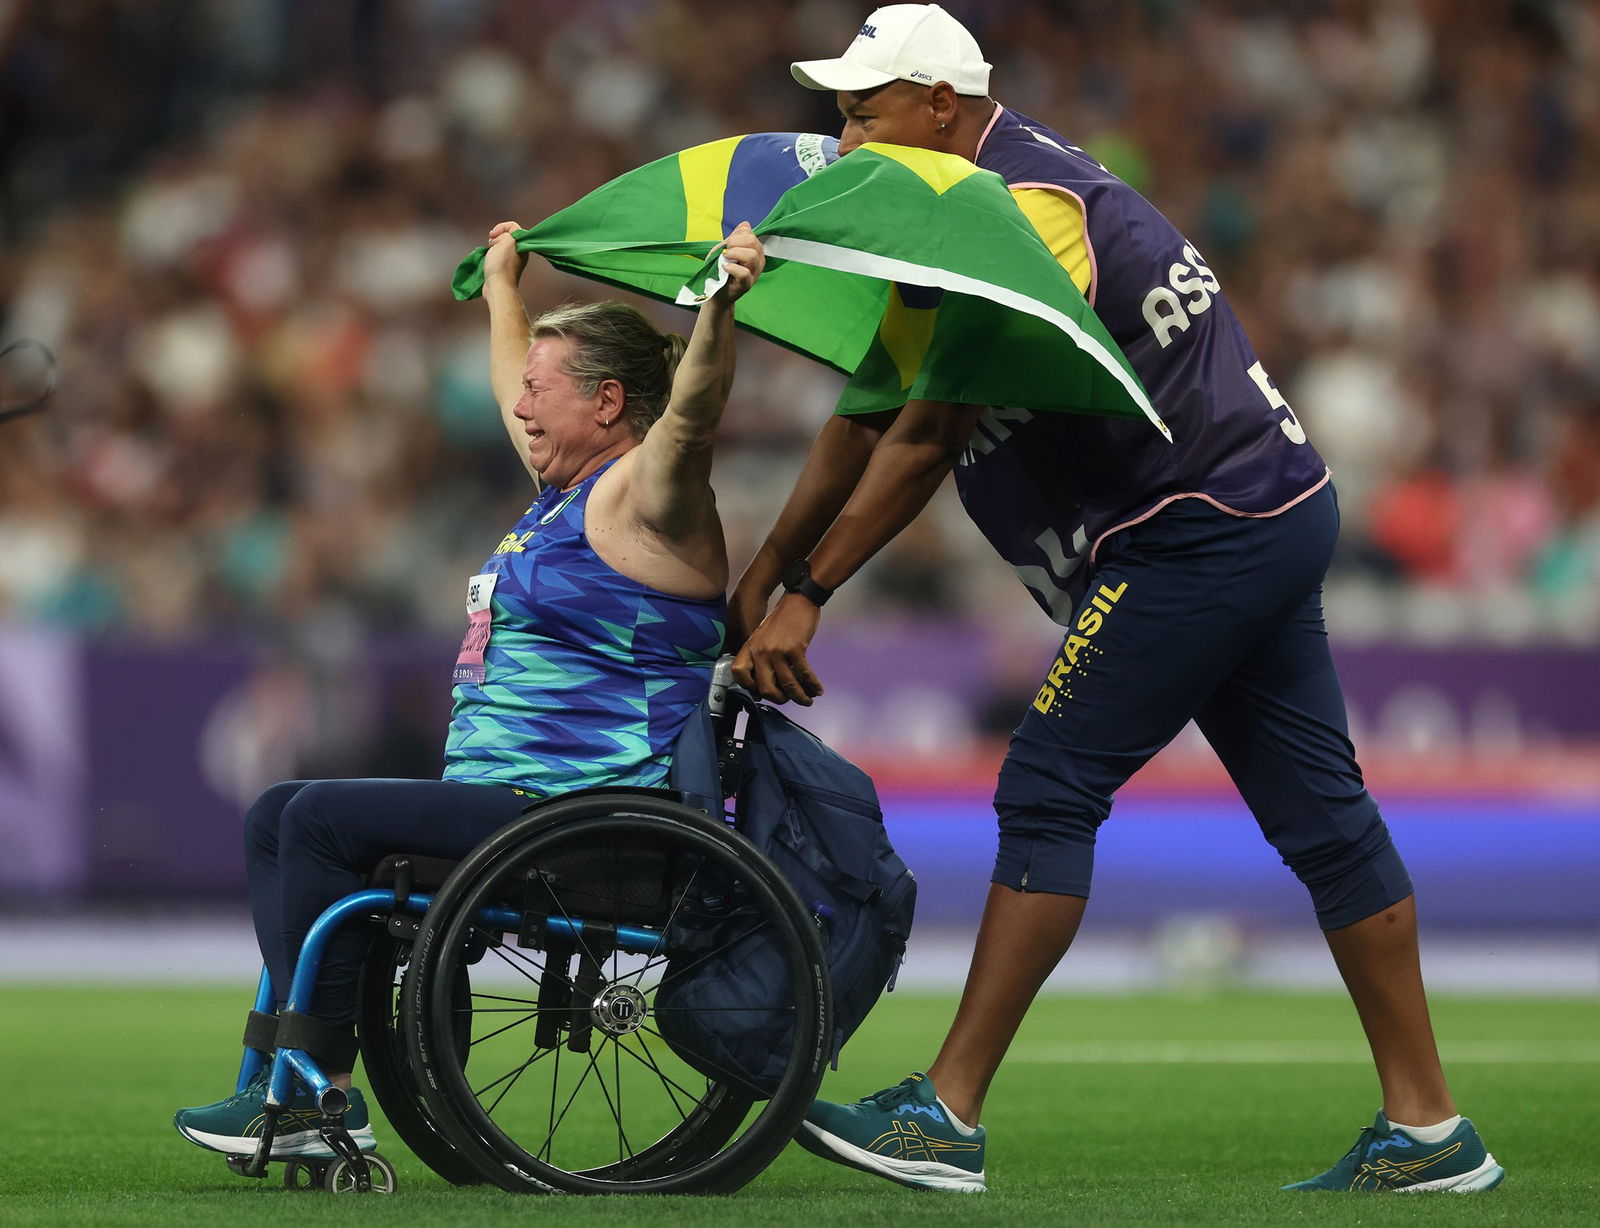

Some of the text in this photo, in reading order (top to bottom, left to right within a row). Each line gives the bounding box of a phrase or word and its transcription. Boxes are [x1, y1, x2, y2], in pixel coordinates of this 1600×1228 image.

[857, 24, 877, 39] SIL
[917, 72, 933, 81] asics
[1141, 239, 1221, 349] ASS
[1032, 581, 1129, 715] BRASIL
[416, 928, 436, 1063] MARATHON PLUS
[617, 1001, 629, 1017] Ti
[811, 964, 825, 1073] SCHWALBE
